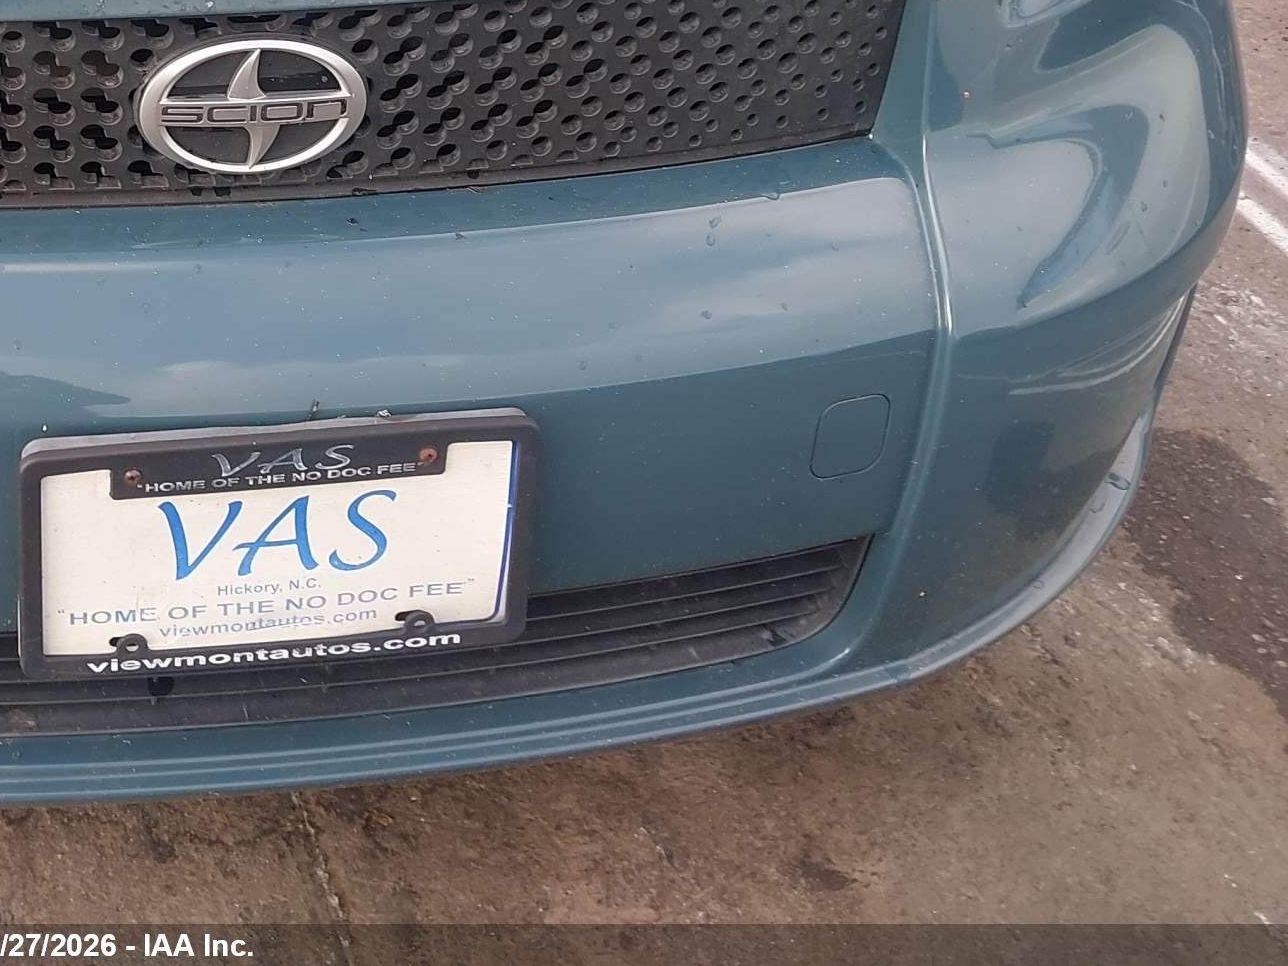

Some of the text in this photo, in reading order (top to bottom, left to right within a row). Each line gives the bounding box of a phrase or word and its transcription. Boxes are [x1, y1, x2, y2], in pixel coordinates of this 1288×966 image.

[211, 444, 355, 477] VAS
[213, 477, 240, 489] OF
[245, 473, 286, 486] THE
[292, 469, 323, 483] NO
[327, 465, 372, 480] DOC
[157, 489, 397, 581] VAS
[289, 577, 322, 591] N.C.
[167, 605, 208, 621] OF
[217, 600, 275, 617] THE
[285, 595, 327, 611] NO
[337, 588, 399, 606] DOC
[86, 634, 461, 674] viewmontautos.com
